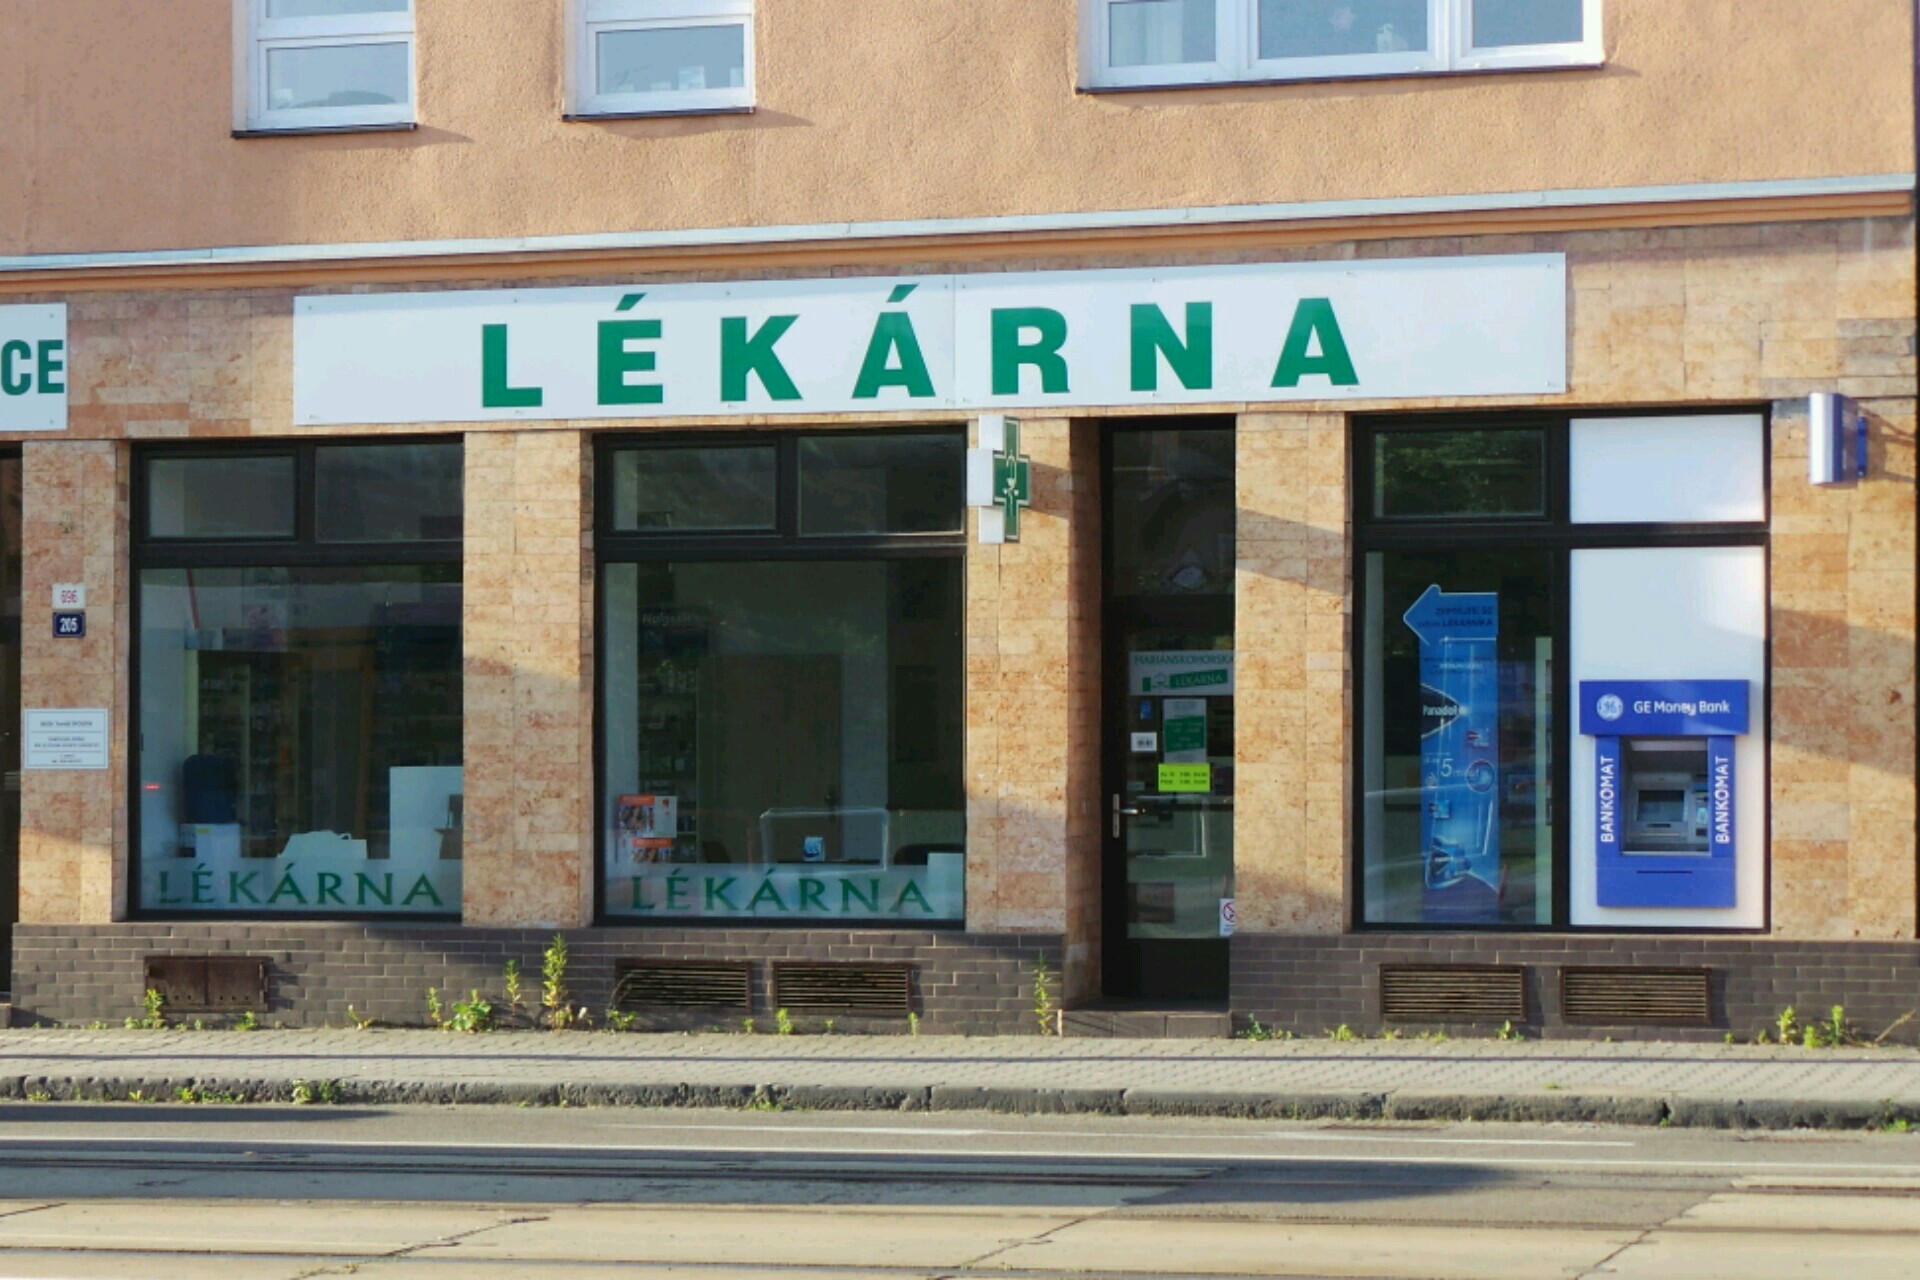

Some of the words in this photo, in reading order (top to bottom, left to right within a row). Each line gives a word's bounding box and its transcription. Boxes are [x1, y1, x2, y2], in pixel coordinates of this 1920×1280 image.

[482, 284, 1360, 407] LÉKÁRNA
[60, 617, 78, 633] 205
[1423, 704, 1458, 716] Panadol
[1634, 702, 1652, 713] GE
[1654, 702, 1696, 715] Money
[1698, 701, 1730, 713] Bank
[1440, 758, 1454, 778] 5
[1600, 756, 1615, 843] BANKOMAT
[1715, 756, 1731, 843] BANKOMAT
[159, 862, 443, 907] LÉKÁRNA
[631, 868, 934, 913] LÉKÁRNA
